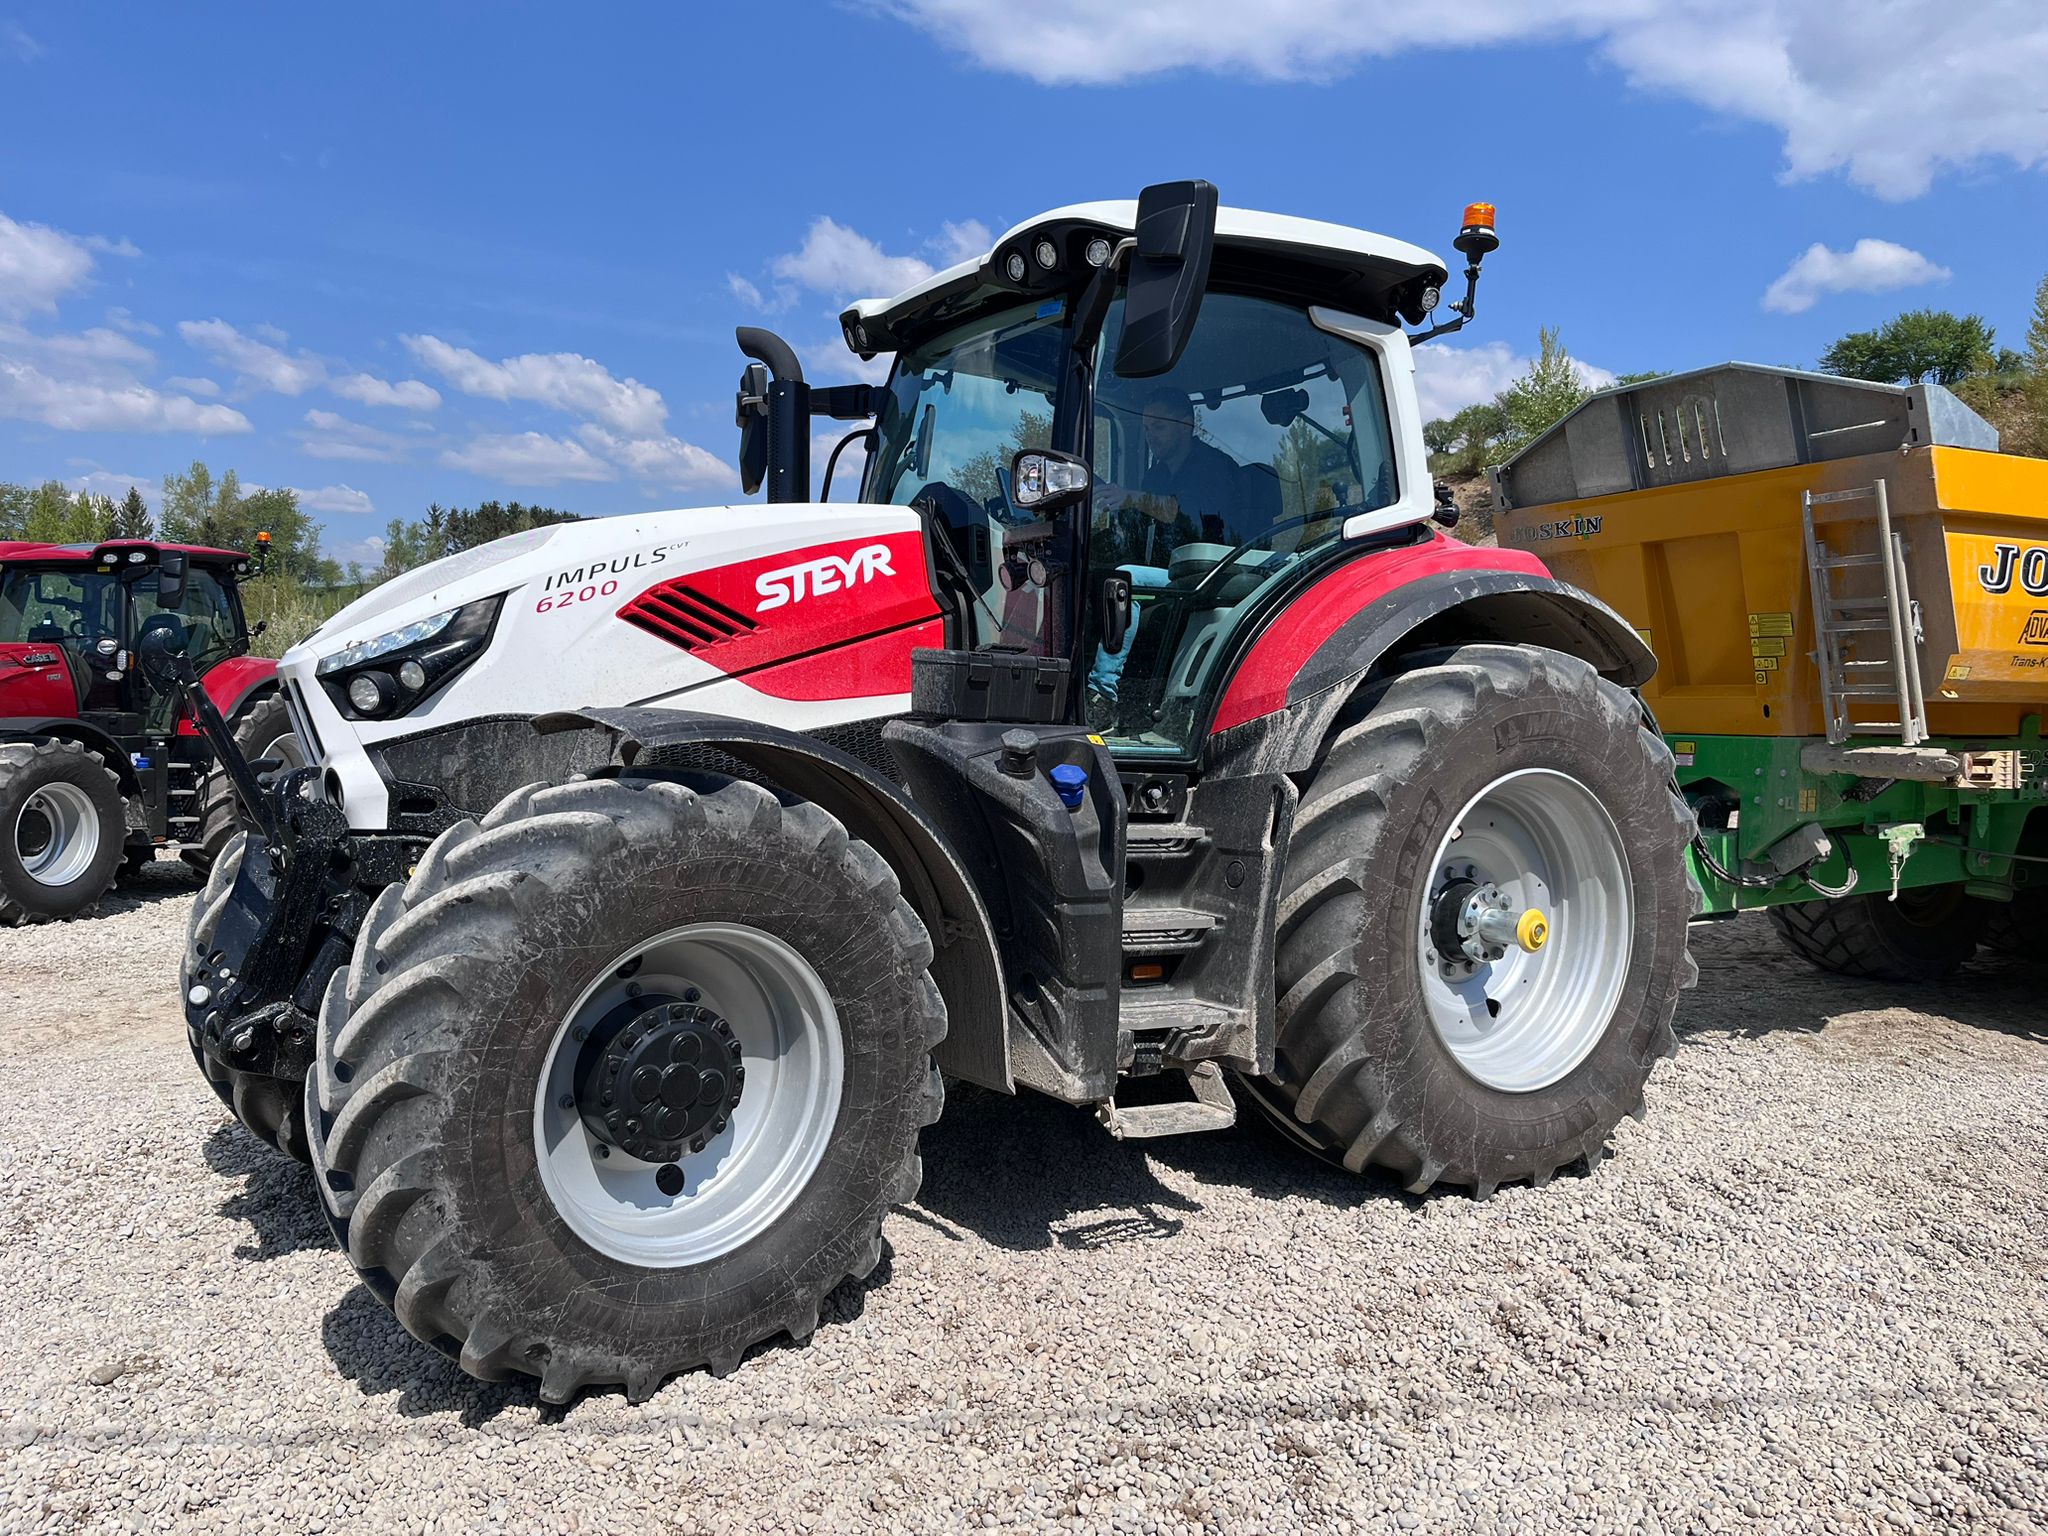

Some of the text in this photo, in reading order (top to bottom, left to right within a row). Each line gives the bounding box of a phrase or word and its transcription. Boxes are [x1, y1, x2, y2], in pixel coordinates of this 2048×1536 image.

[1511, 515, 1602, 544] JOSKIN
[545, 541, 690, 591] IMPULS CVT
[755, 544, 897, 613] STEYR
[536, 580, 618, 613] 6200
[2010, 655, 2048, 668] Trans-K
